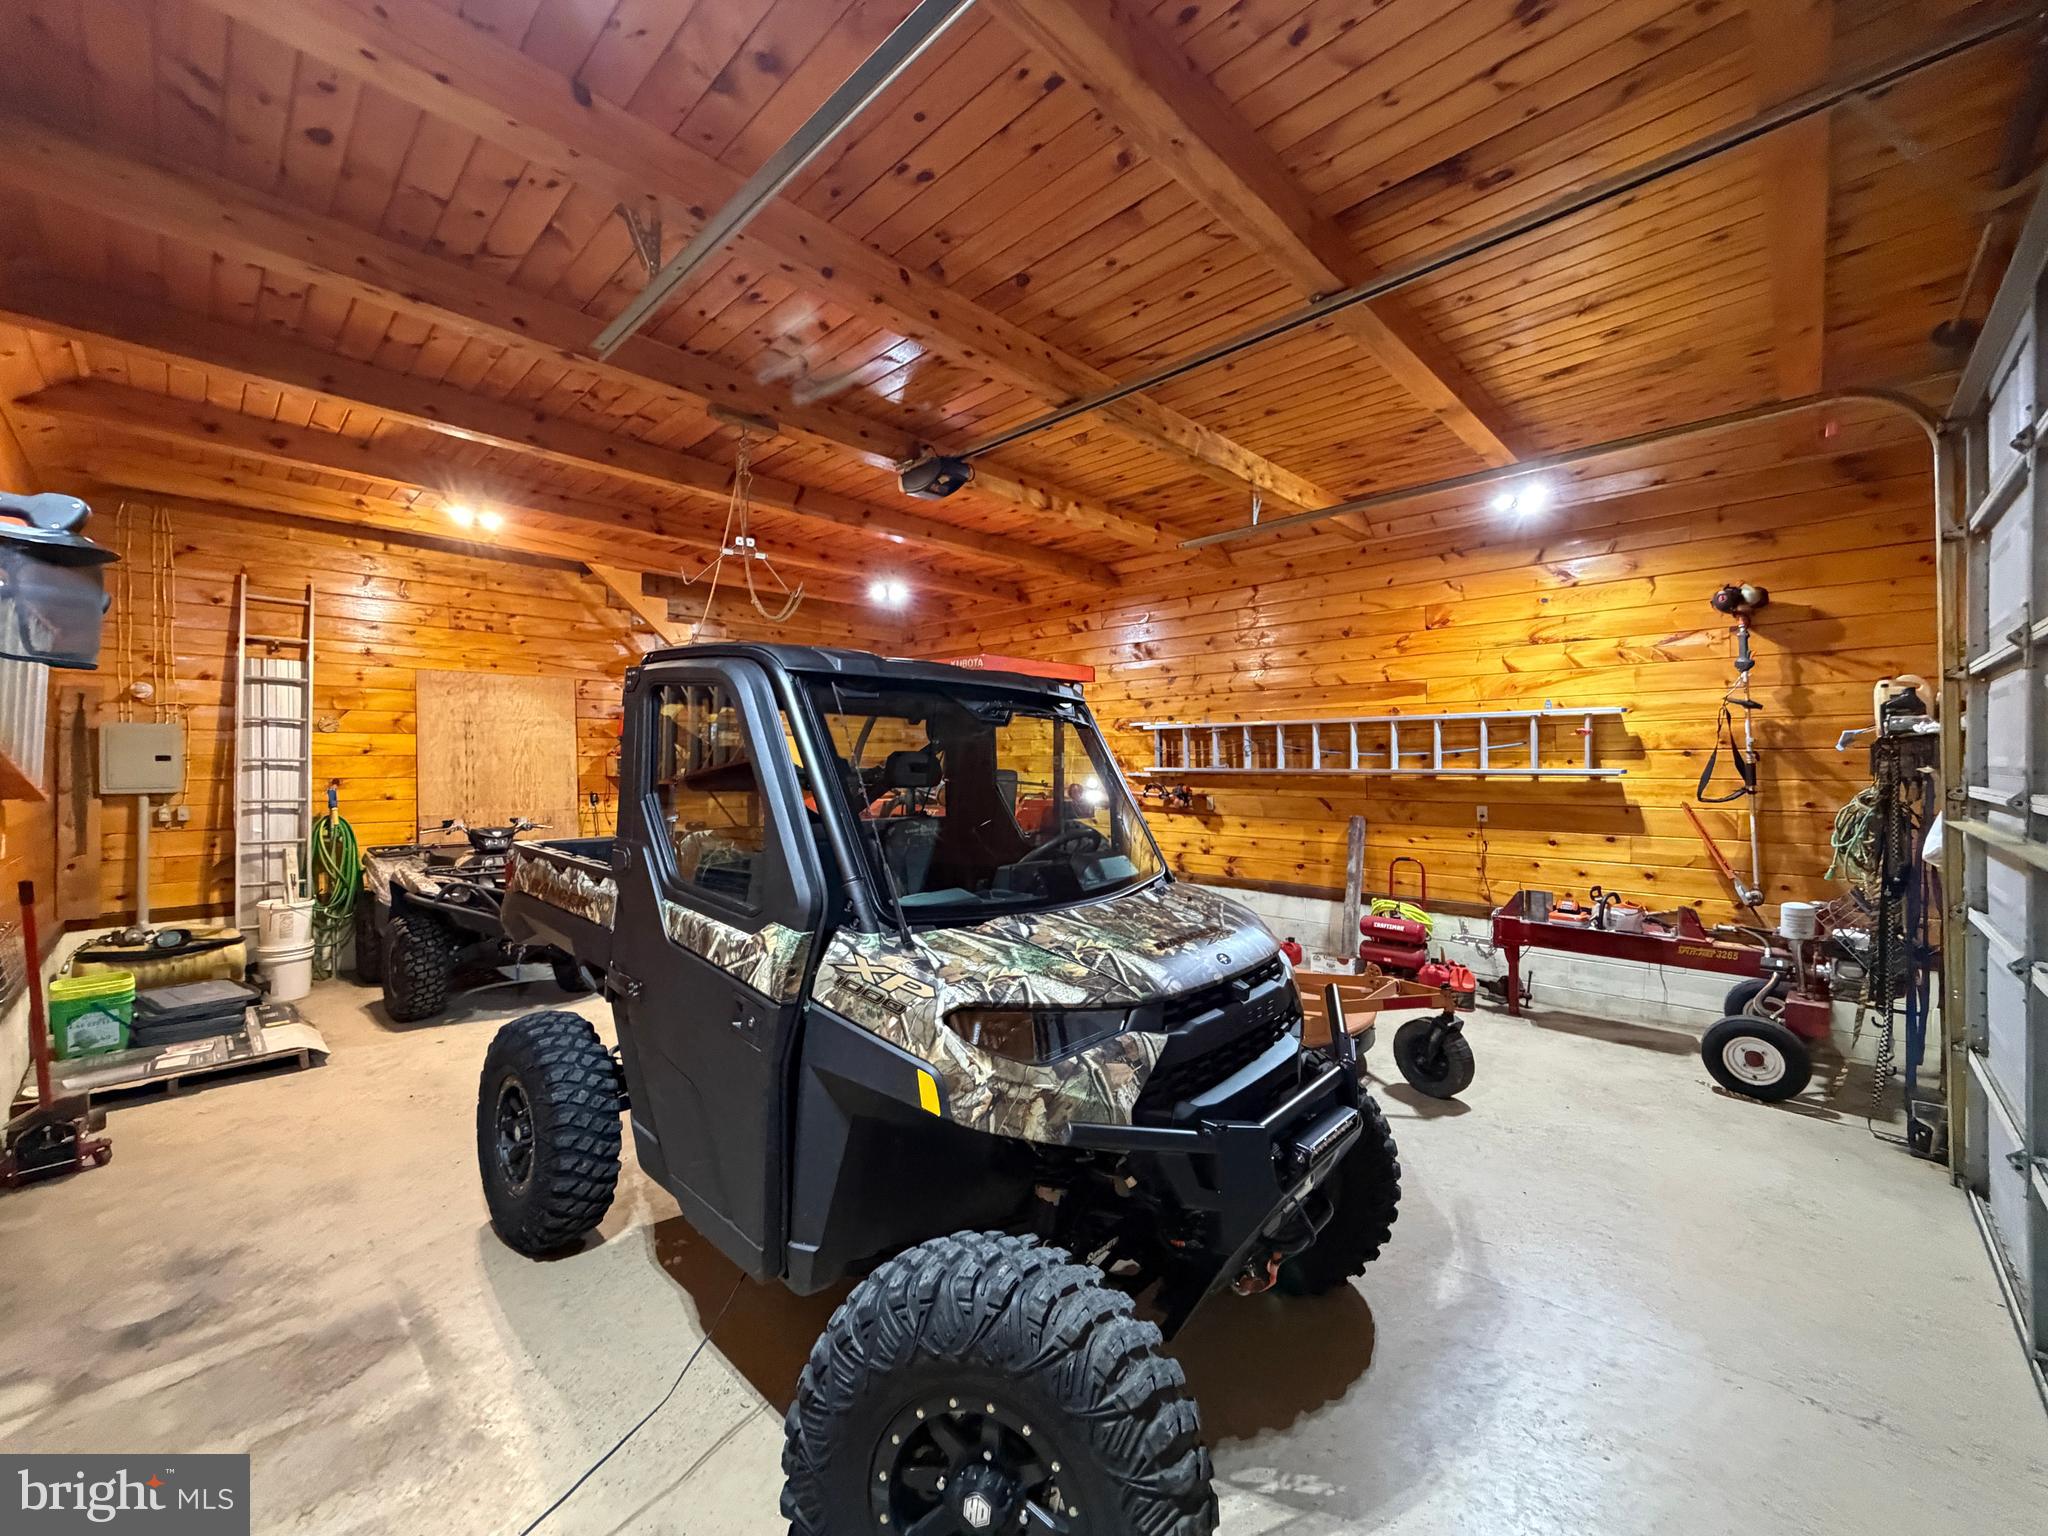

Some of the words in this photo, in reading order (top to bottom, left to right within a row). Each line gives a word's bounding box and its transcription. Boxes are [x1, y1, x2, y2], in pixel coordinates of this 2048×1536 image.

[1373, 921, 1405, 931] CRAFTSMAN
[1715, 950, 1739, 961] 3265
[827, 952, 937, 999] XP
